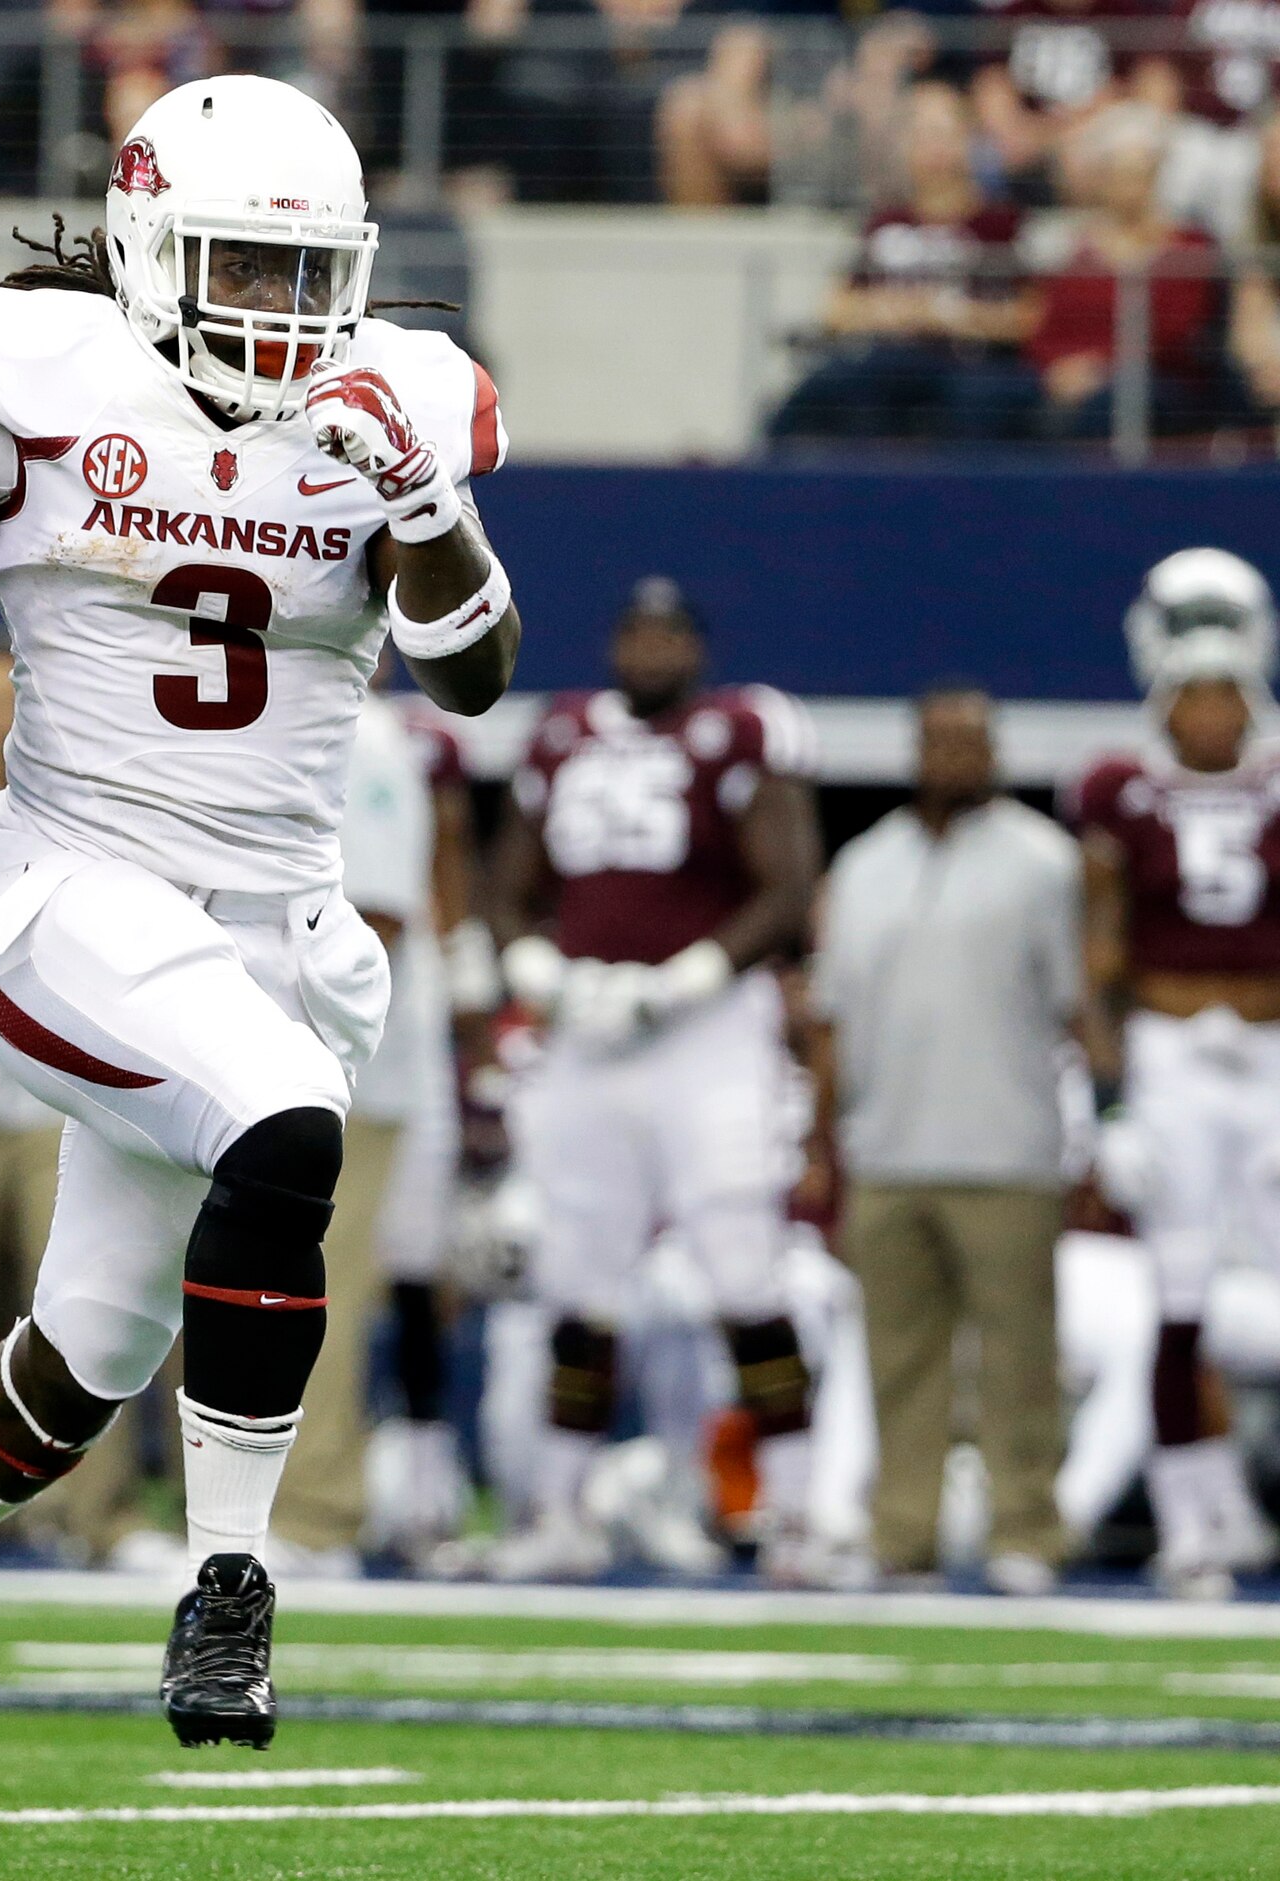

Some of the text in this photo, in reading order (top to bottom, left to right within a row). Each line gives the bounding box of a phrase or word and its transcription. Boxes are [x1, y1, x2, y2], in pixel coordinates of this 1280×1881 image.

[269, 197, 310, 211] HOGS
[85, 435, 144, 495] SEC
[82, 499, 350, 562] ARKANSAS
[149, 562, 274, 731] 3
[1176, 805, 1269, 928] 5
